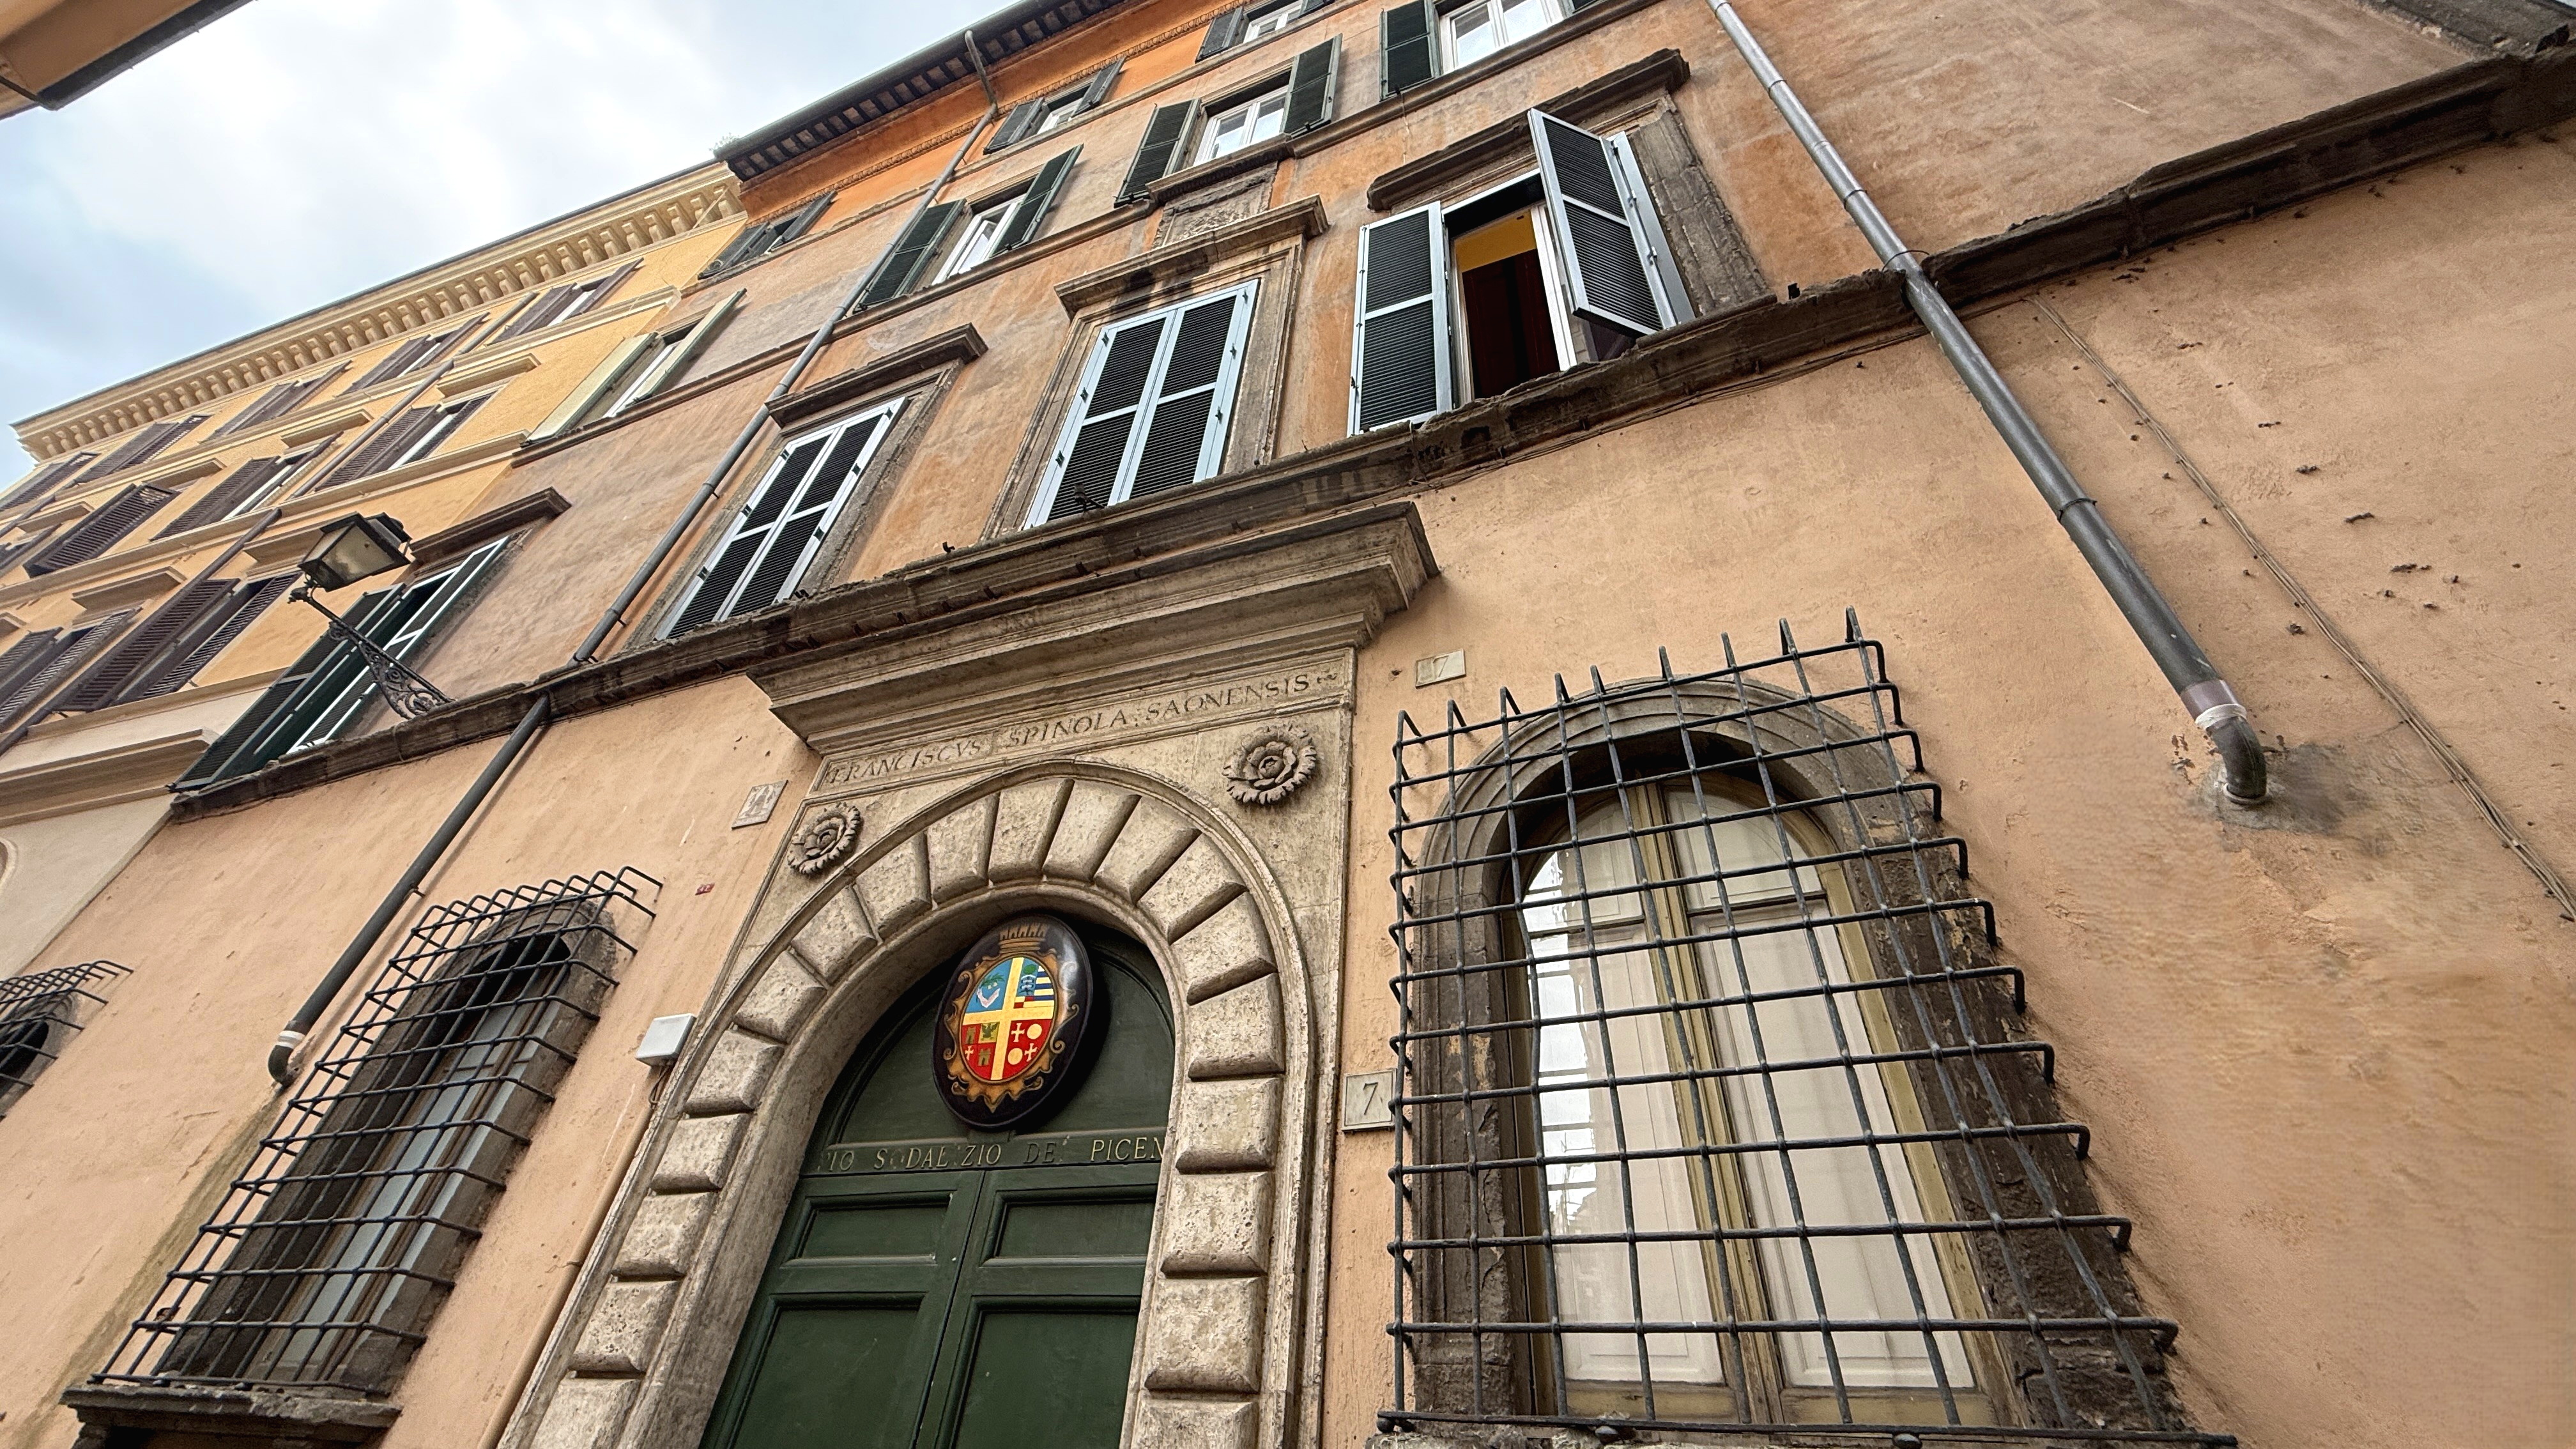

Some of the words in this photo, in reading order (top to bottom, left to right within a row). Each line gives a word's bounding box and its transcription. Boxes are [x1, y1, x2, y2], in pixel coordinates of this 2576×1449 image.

[1363, 1082, 1379, 1116] 7
[818, 1150, 854, 1172] IO
[873, 1144, 1002, 1170] SDALZIO
